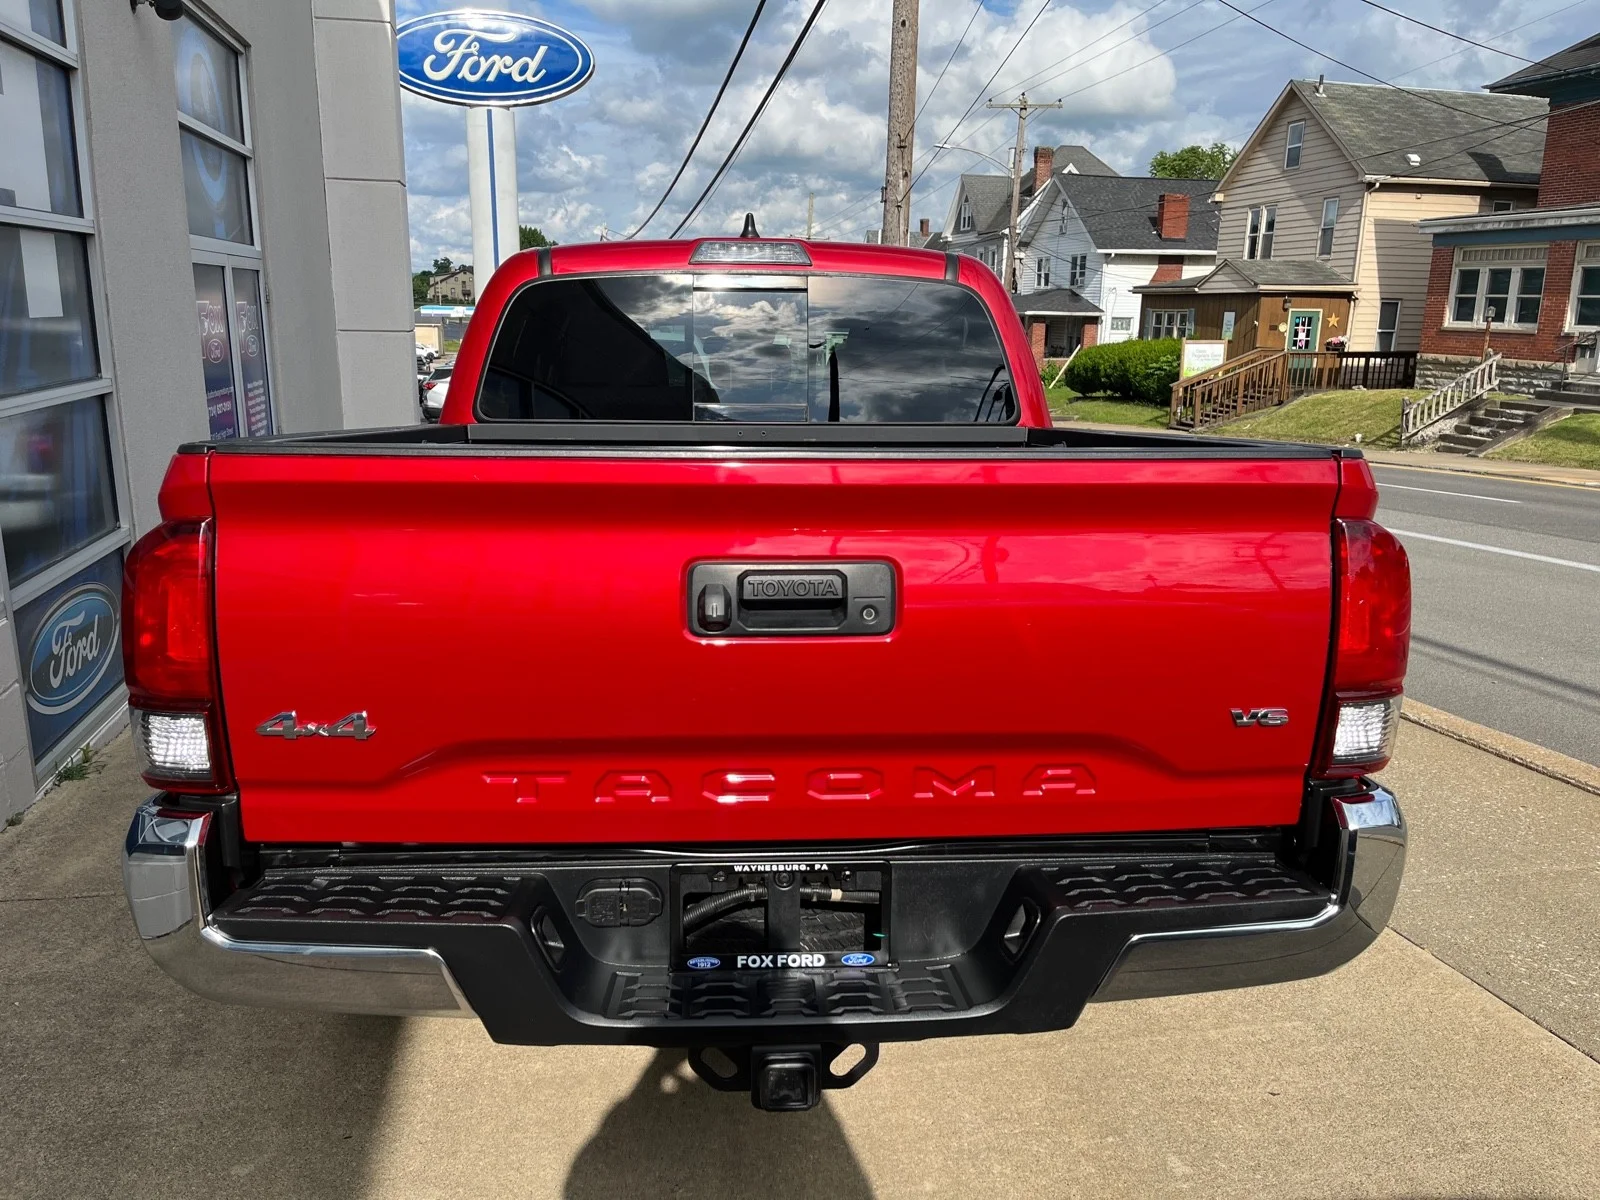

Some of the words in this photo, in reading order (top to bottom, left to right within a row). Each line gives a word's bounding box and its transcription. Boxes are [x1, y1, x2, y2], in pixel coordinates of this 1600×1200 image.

[423, 28, 548, 83] Ford
[748, 578, 839, 597] TOYOTA
[50, 609, 101, 688] Ford
[255, 710, 377, 740] 4x4
[1229, 707, 1289, 726] V6
[481, 761, 1099, 804] TACOMA
[733, 864, 810, 872] WAYNESBURG,
[814, 863, 829, 871] PA
[737, 955, 774, 968] FOX
[777, 954, 826, 968] FORD
[847, 955, 868, 964] Ford
